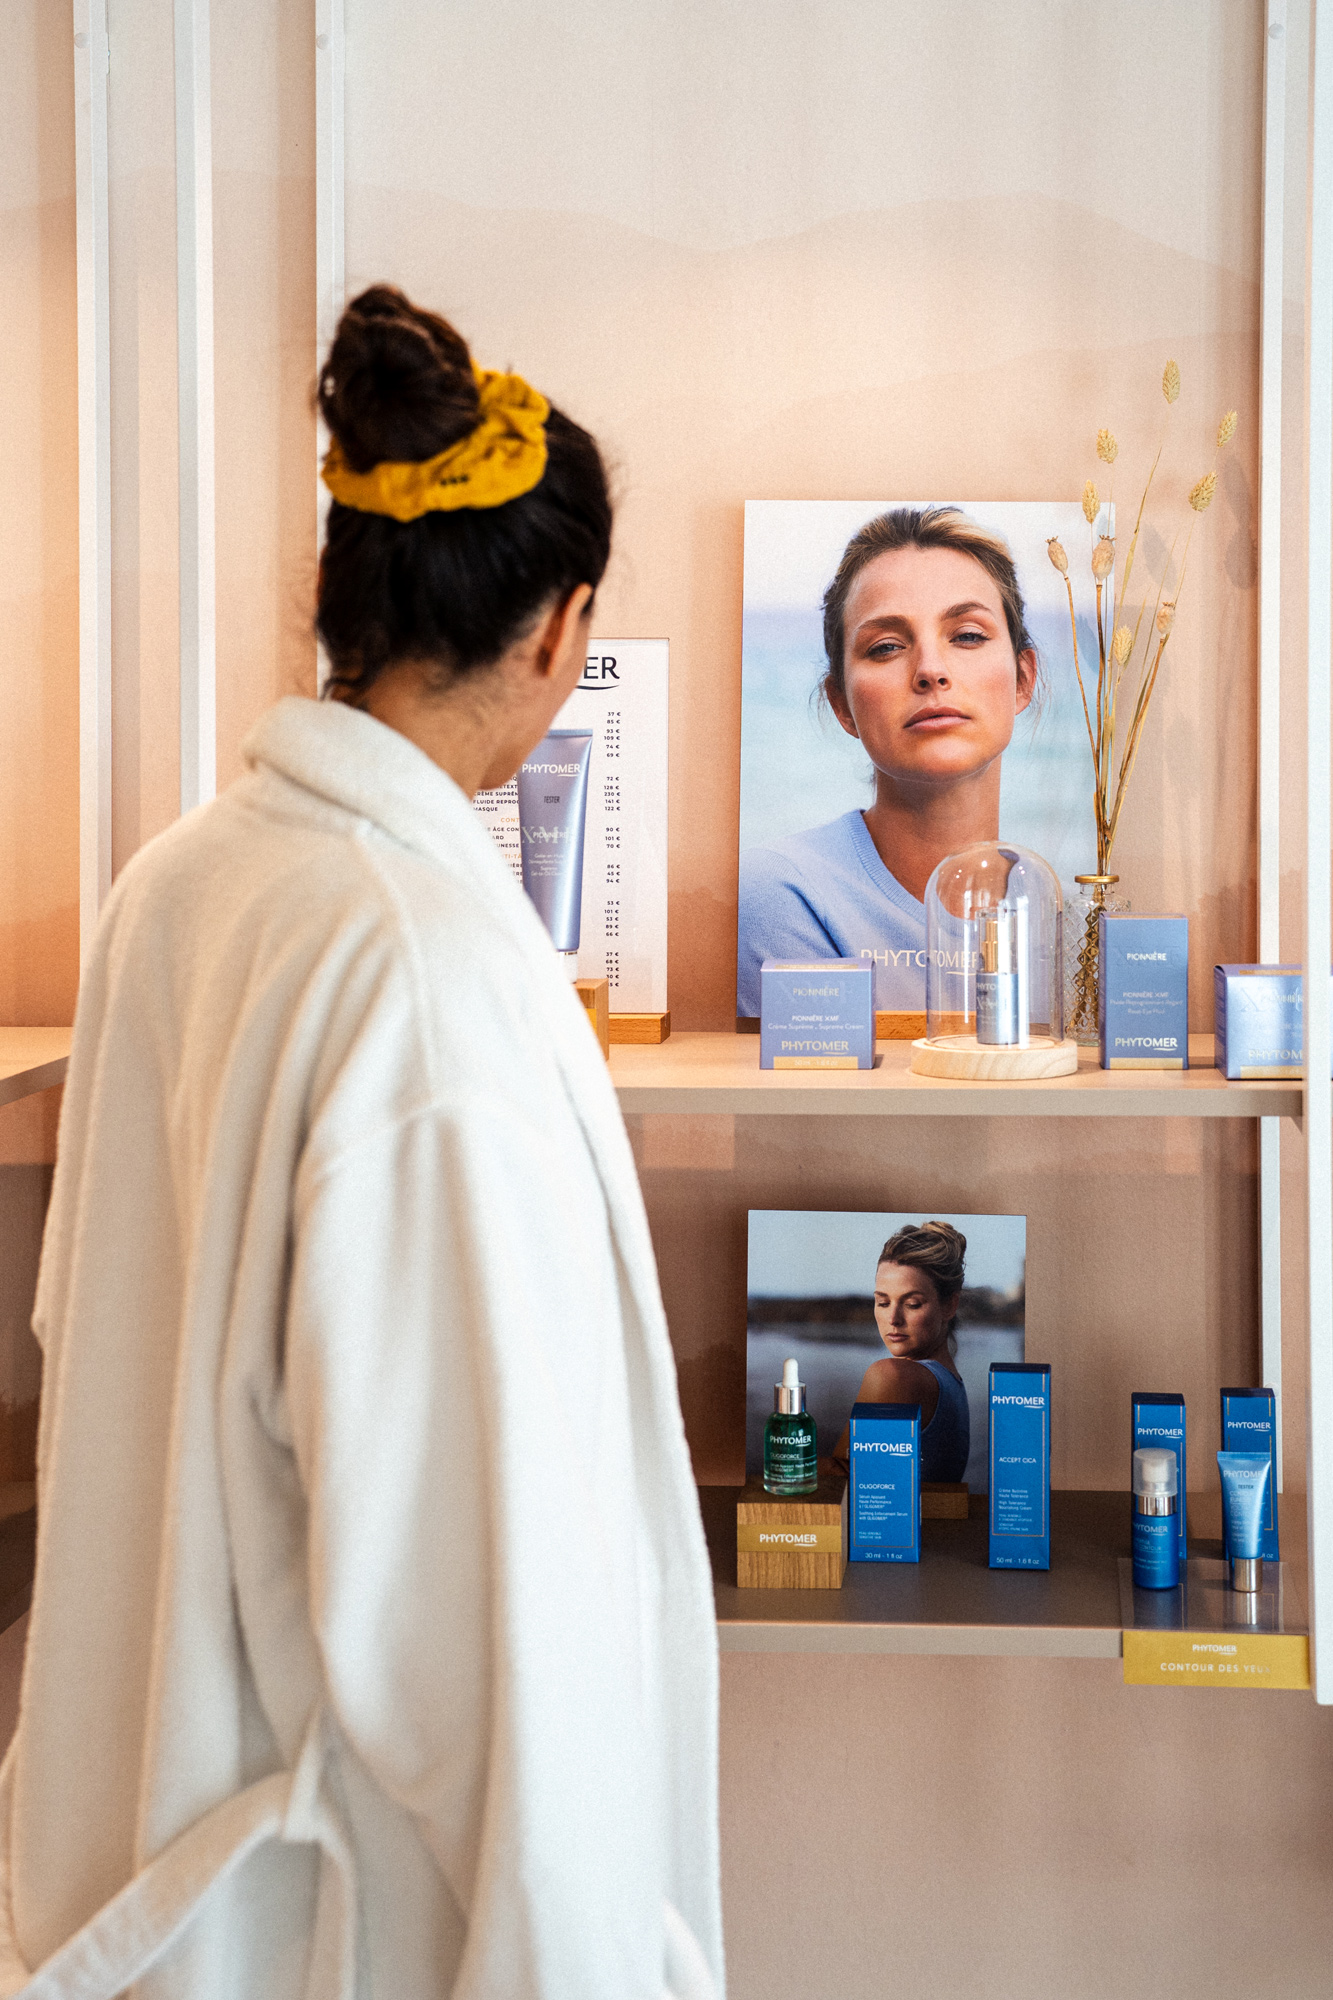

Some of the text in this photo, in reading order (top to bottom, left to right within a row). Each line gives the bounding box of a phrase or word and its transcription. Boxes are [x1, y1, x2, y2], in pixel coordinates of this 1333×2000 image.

[522, 763, 581, 774] PHYTOMER
[1126, 950, 1167, 961] PIONNIÈRE
[793, 985, 840, 996] PIONNIÈRE
[781, 1040, 849, 1051] PHYTOMER
[1114, 1037, 1178, 1047] PHYTOMER
[1248, 1049, 1303, 1060] PHYTOM
[992, 1395, 1045, 1406] PHYTOMER
[1227, 1421, 1271, 1430] PHYTOMER
[1137, 1427, 1183, 1436] PHYTOMER
[769, 1434, 812, 1445] PHYTOMER
[853, 1442, 913, 1453] PHYTOMER
[759, 1533, 818, 1543] PHYTOMER
[1192, 1644, 1237, 1653] PHYTOMER
[1160, 1662, 1214, 1672] CONTOUR
[1218, 1663, 1239, 1673] DES
